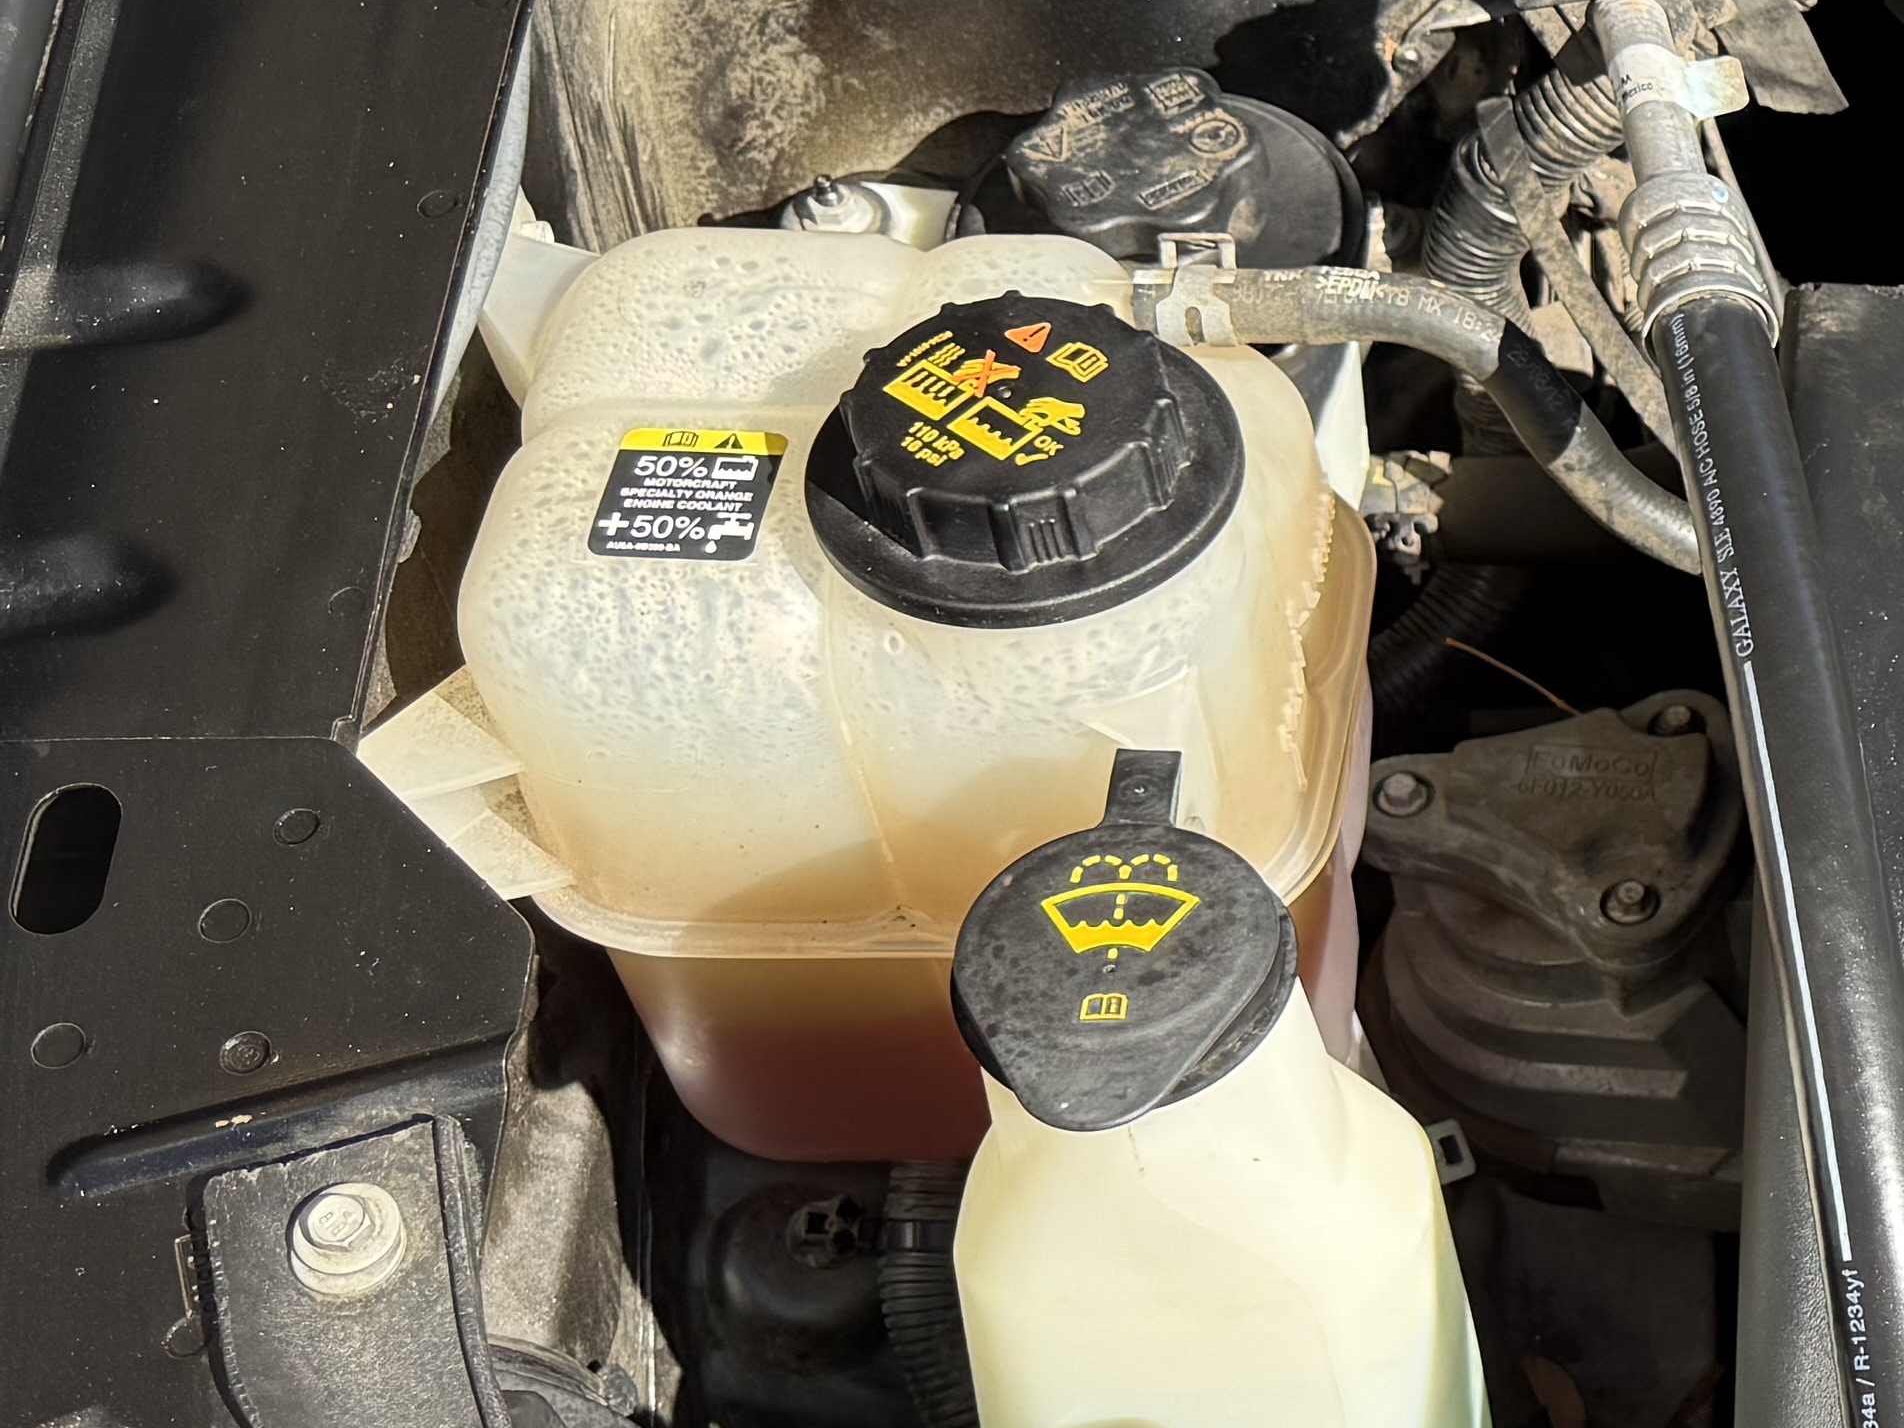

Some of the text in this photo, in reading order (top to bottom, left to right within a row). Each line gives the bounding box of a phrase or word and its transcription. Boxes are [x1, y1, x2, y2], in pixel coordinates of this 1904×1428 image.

[908, 422, 965, 461] 110 kPa
[1034, 435, 1064, 456] OK
[634, 455, 708, 477] 50%
[914, 448, 949, 467] psi
[620, 487, 753, 501] SPECIALTY ORANGE
[643, 477, 738, 490] MOTORCRAFT
[1669, 313, 1754, 657] GALAXY SLE 4890 A/C HOSE 5/8 in (16mm)
[623, 499, 743, 512] ENGINE COOLANT
[1841, 1269, 1871, 1372] R-1234yf
